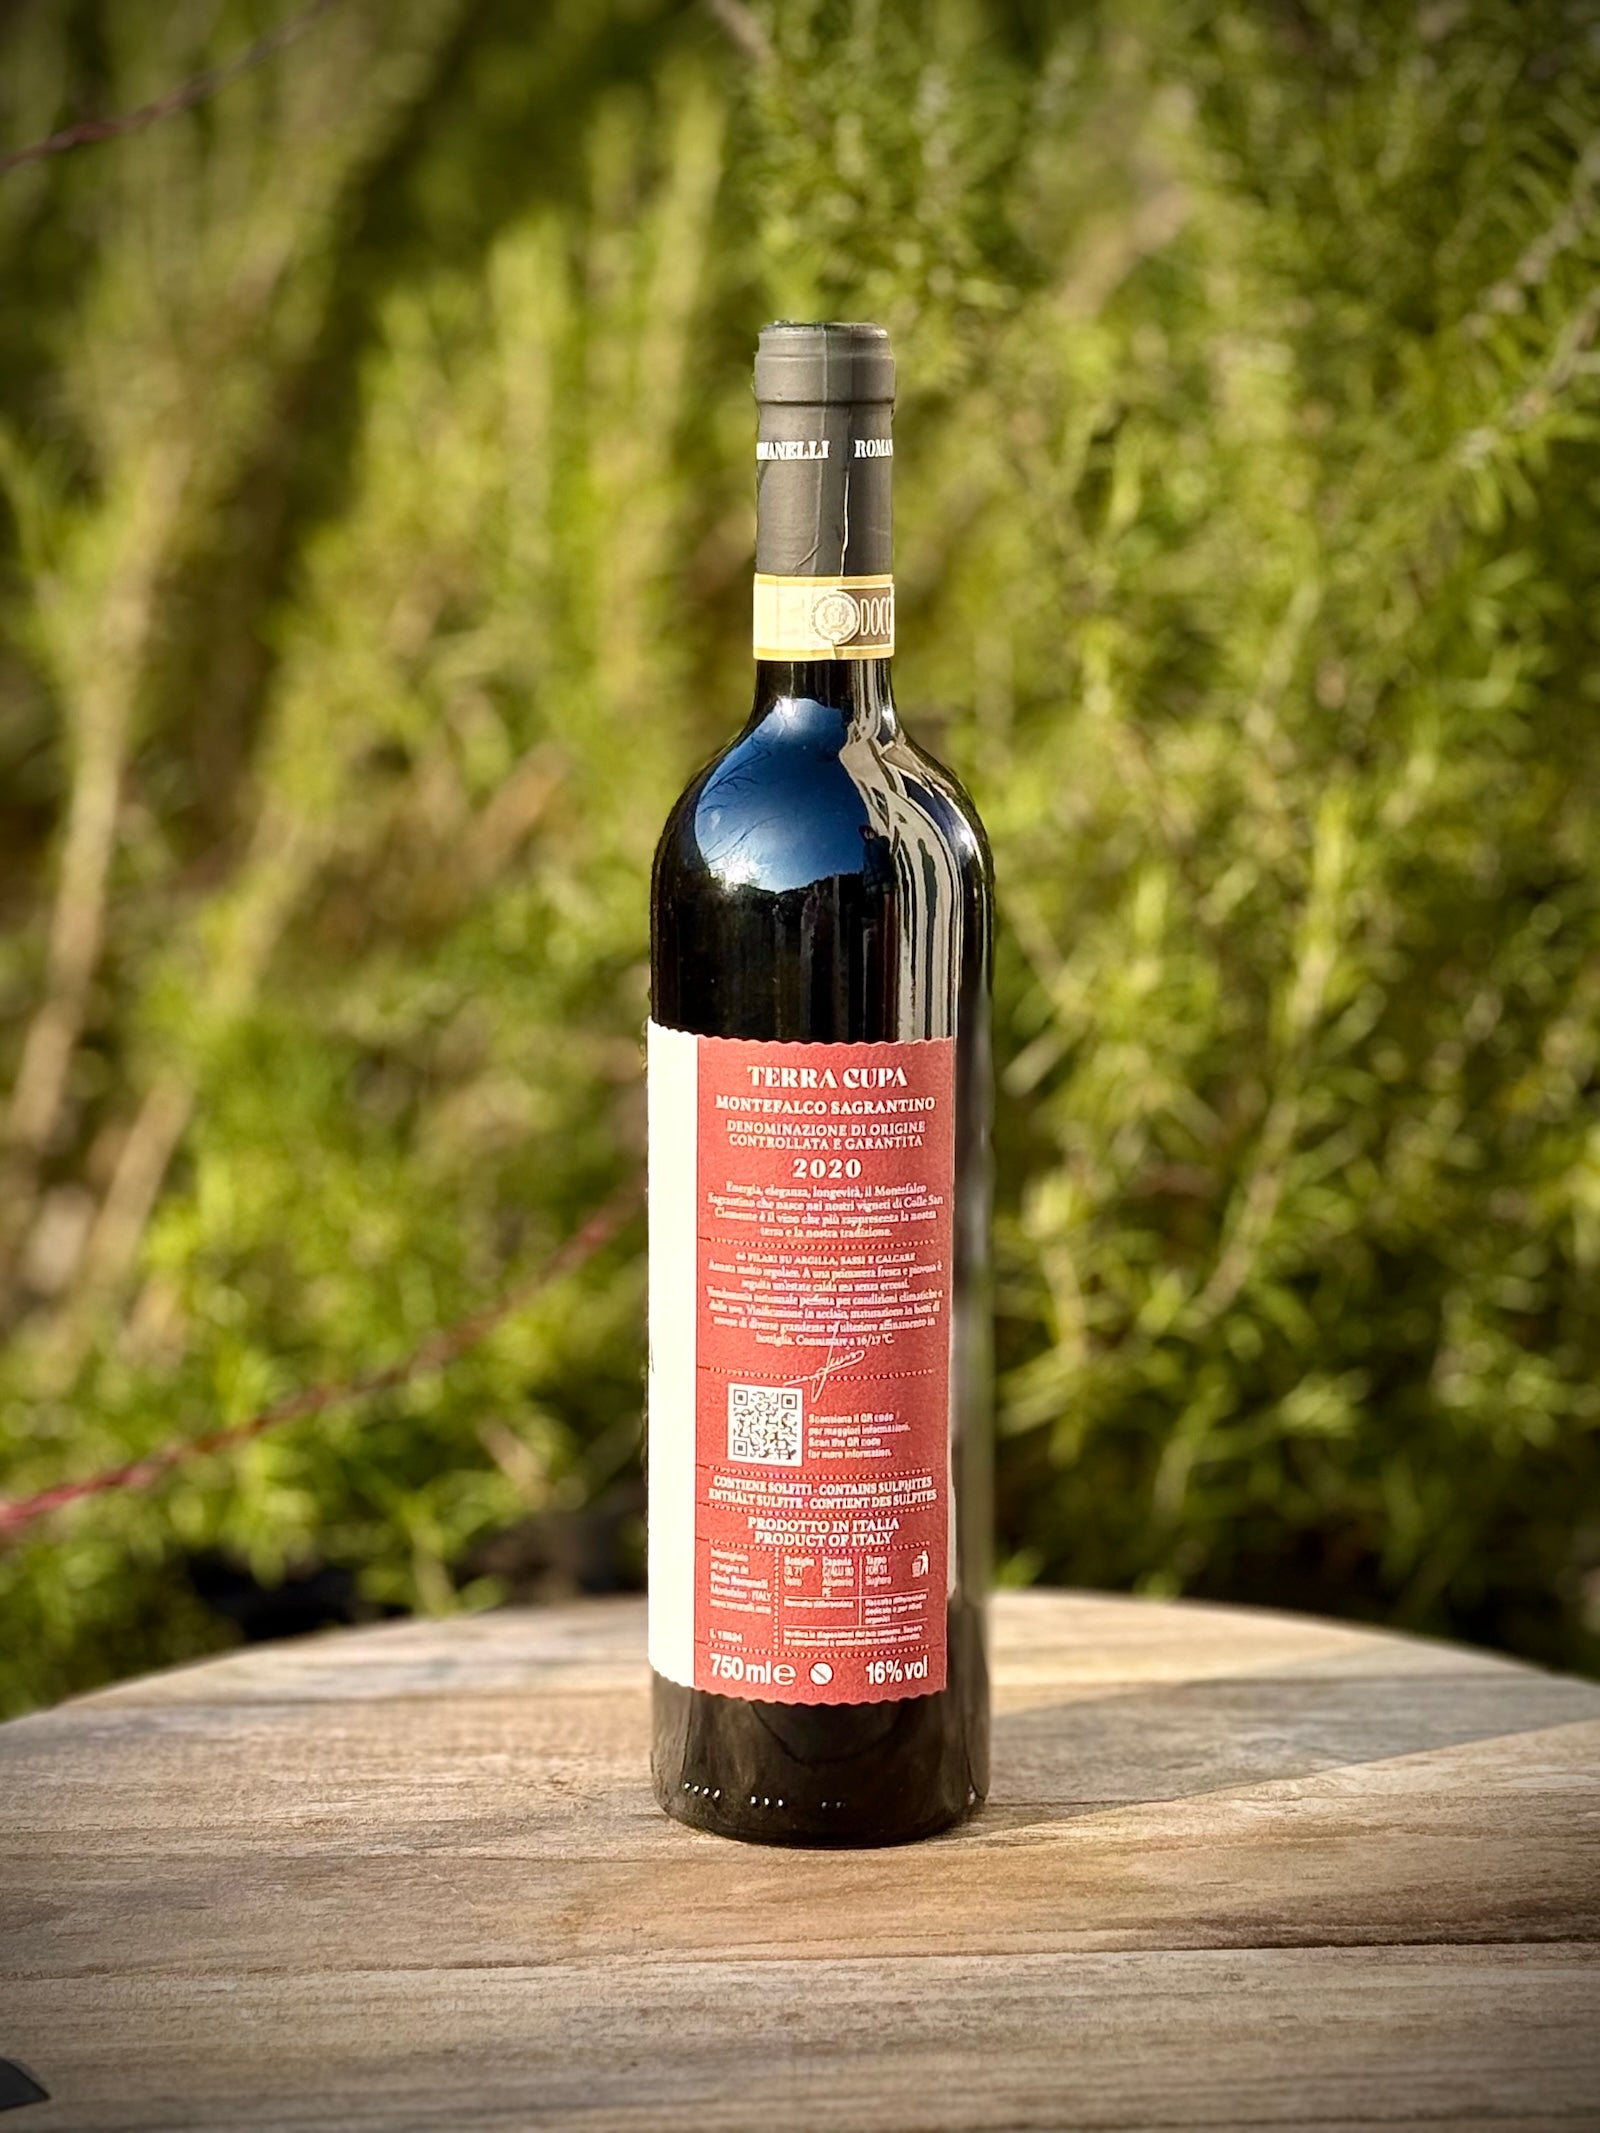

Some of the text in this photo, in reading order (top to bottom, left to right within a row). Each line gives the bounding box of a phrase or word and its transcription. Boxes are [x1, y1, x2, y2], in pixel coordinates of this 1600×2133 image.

[747, 1066, 907, 1089] TERRA CUPA
[715, 1094, 936, 1115] MONTEFALCO SAGRANTINO
[727, 1120, 925, 1137] DENOMINAZIONE DI ORIGINE
[729, 1134, 923, 1150] CONTROLLATA E GARANTITA
[792, 1158, 862, 1179] 2020
[874, 1182, 927, 1197] Montefalco
[756, 1197, 774, 1209] che
[776, 1201, 804, 1211] nasce
[825, 1200, 854, 1211] nostri
[856, 1199, 891, 1212] vigneti
[892, 1198, 902, 1209] di
[928, 1195, 943, 1206] San
[801, 1212, 820, 1224] che
[785, 1229, 792, 1237] e
[794, 1225, 804, 1237] la
[806, 1228, 838, 1238] nostra
[713, 1475, 933, 1496] CONTIENE SOLFITI CONTAINS SULPHITES
[756, 1494, 803, 1509] SULFITE
[809, 1496, 870, 1510] CONTIENT
[871, 1495, 892, 1508] DES
[893, 1489, 937, 1506] SULFITES
[747, 1516, 900, 1533] PRODOTTO IN ITALIA
[755, 1530, 894, 1547] PRODUCT OF ITALY
[710, 1652, 743, 1680] 750
[865, 1655, 928, 1684] 16% vol
